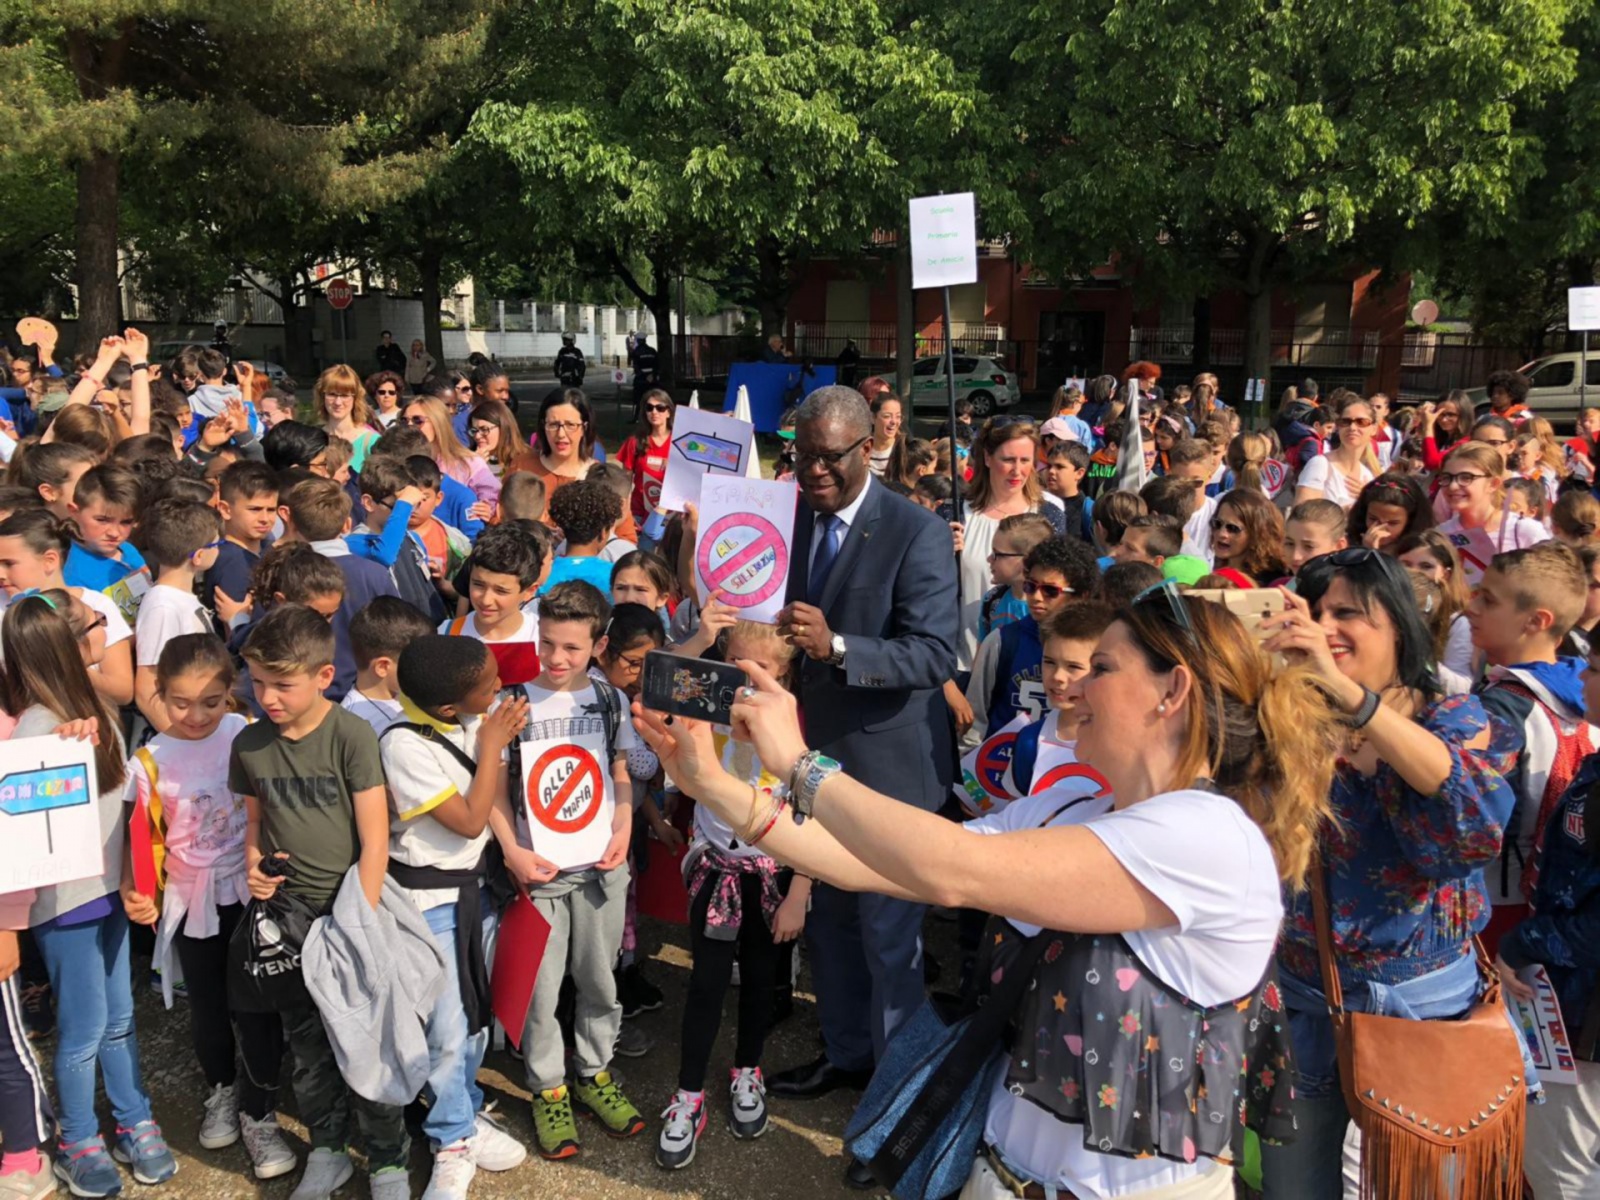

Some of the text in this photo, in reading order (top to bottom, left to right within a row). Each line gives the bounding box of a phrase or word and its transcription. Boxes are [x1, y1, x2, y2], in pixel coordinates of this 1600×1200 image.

[329, 288, 350, 299] STOP
[711, 484, 775, 508] SARA
[715, 538, 739, 558] AL
[0, 776, 83, 801] AMICIZIA
[543, 760, 575, 804] ALLA
[562, 784, 592, 819] MAFIA
